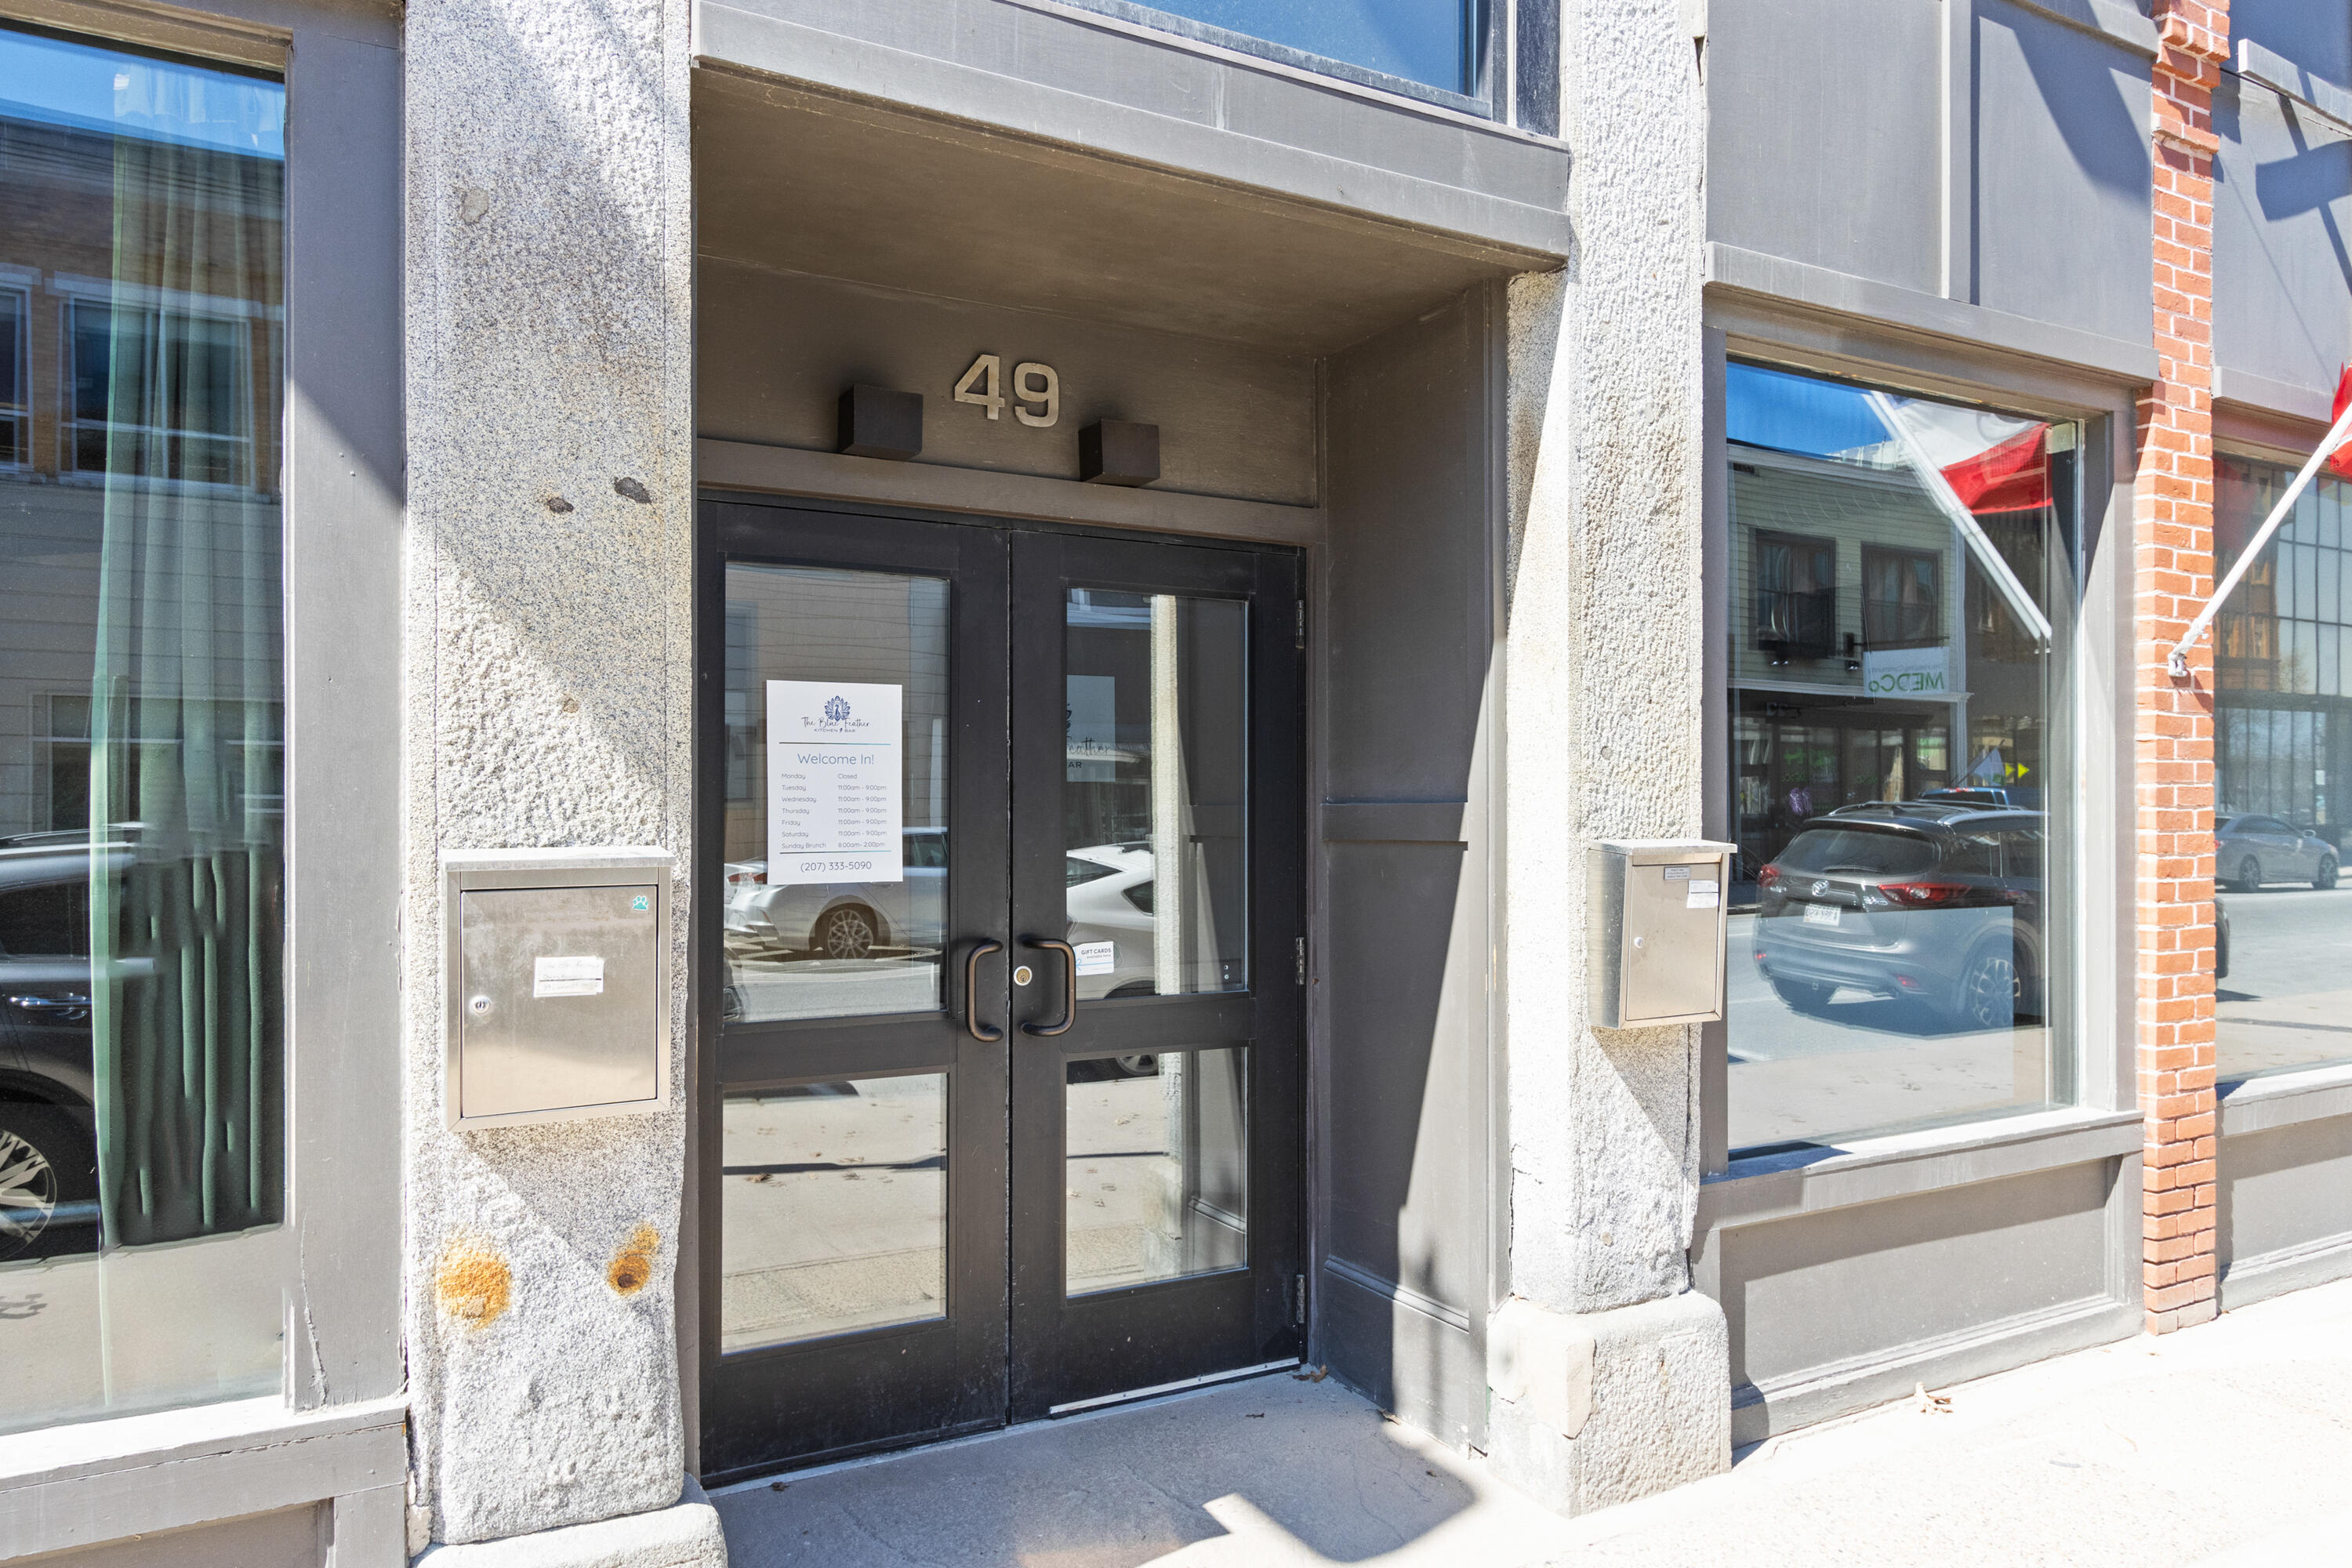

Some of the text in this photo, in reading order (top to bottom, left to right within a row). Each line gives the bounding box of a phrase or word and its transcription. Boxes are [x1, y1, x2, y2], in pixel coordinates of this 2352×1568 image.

[954, 354, 1059, 428] 49
[801, 717, 869, 728] The Blue Feather
[1066, 735, 1111, 757] eather
[797, 753, 874, 765] Welcome In!
[800, 861, 872, 873] (207) 333-5090
